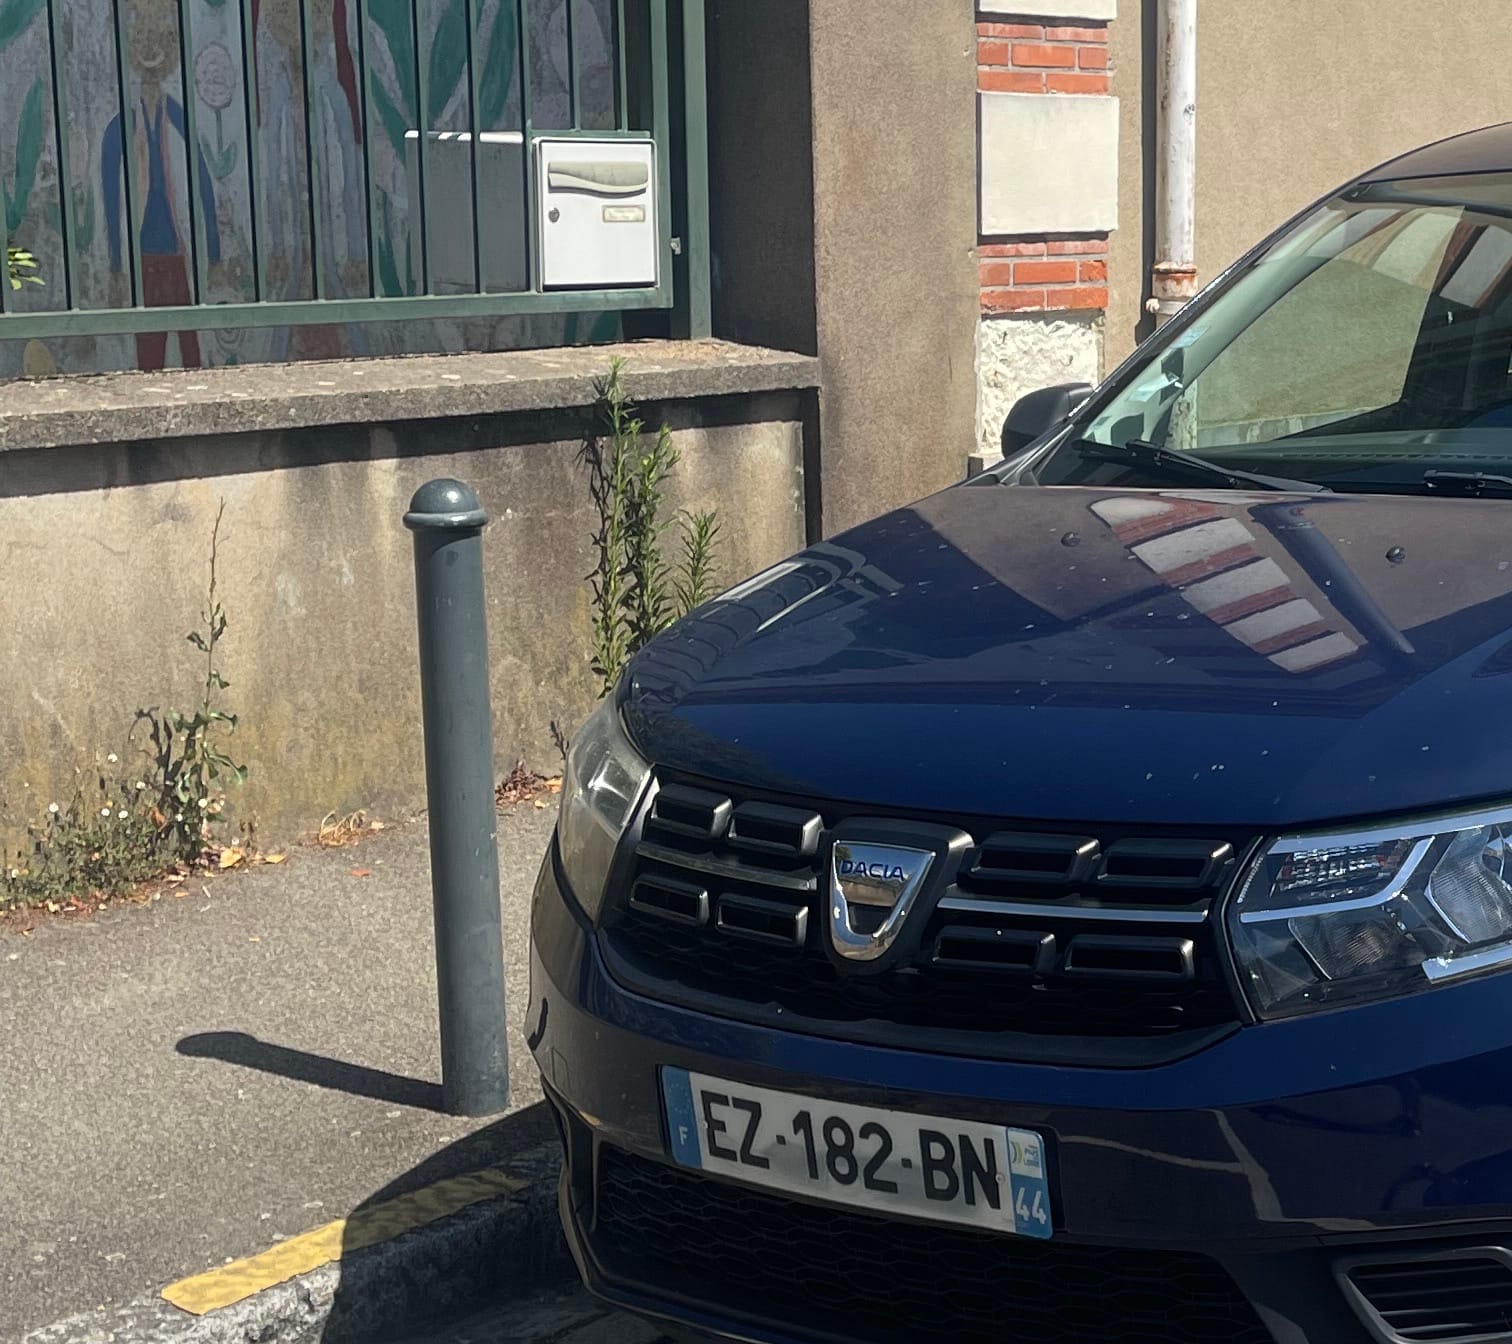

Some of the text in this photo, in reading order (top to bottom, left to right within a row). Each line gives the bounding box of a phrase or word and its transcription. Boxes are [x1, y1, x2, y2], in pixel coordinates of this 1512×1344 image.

[840, 859, 905, 882] DACIA
[678, 1125, 689, 1145] F
[1016, 1187, 1047, 1225] 44
